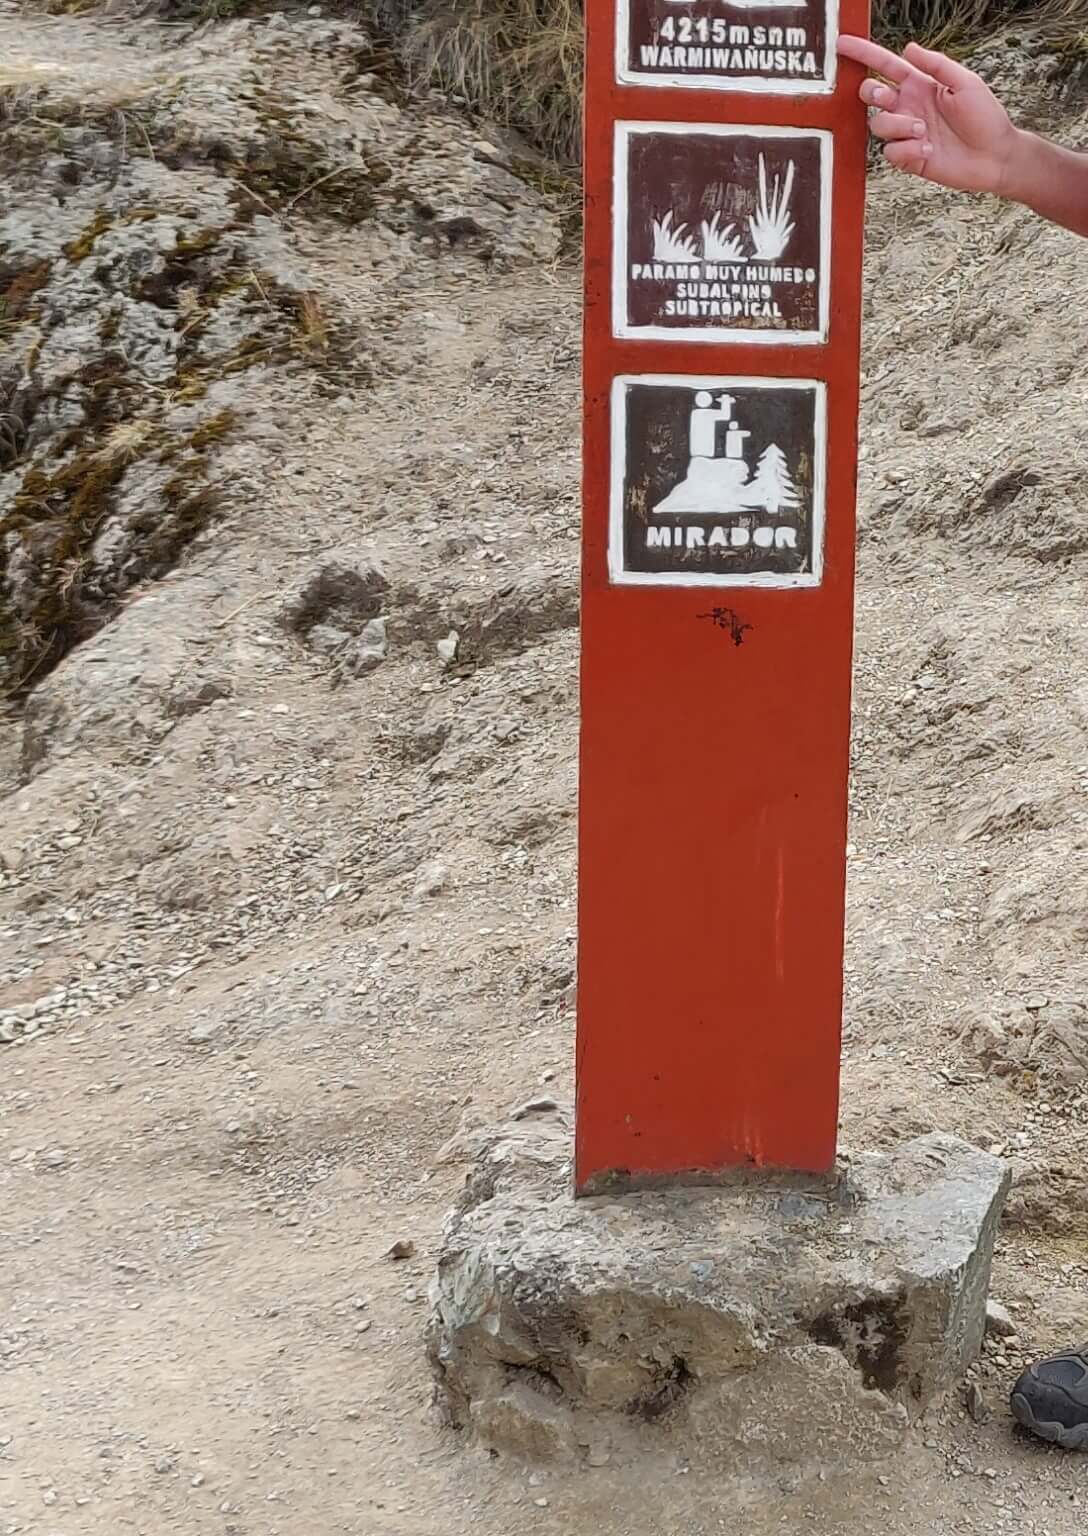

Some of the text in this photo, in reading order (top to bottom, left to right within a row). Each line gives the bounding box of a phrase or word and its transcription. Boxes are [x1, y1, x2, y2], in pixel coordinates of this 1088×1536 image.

[640, 45, 816, 73] WARMIWAÑUSKA
[632, 264, 816, 283] PARAMO MUY HUMEDO
[676, 283, 772, 301] SUBALPINO
[664, 300, 783, 317] SUBTROPICAL
[646, 526, 797, 549] MIRADOR
